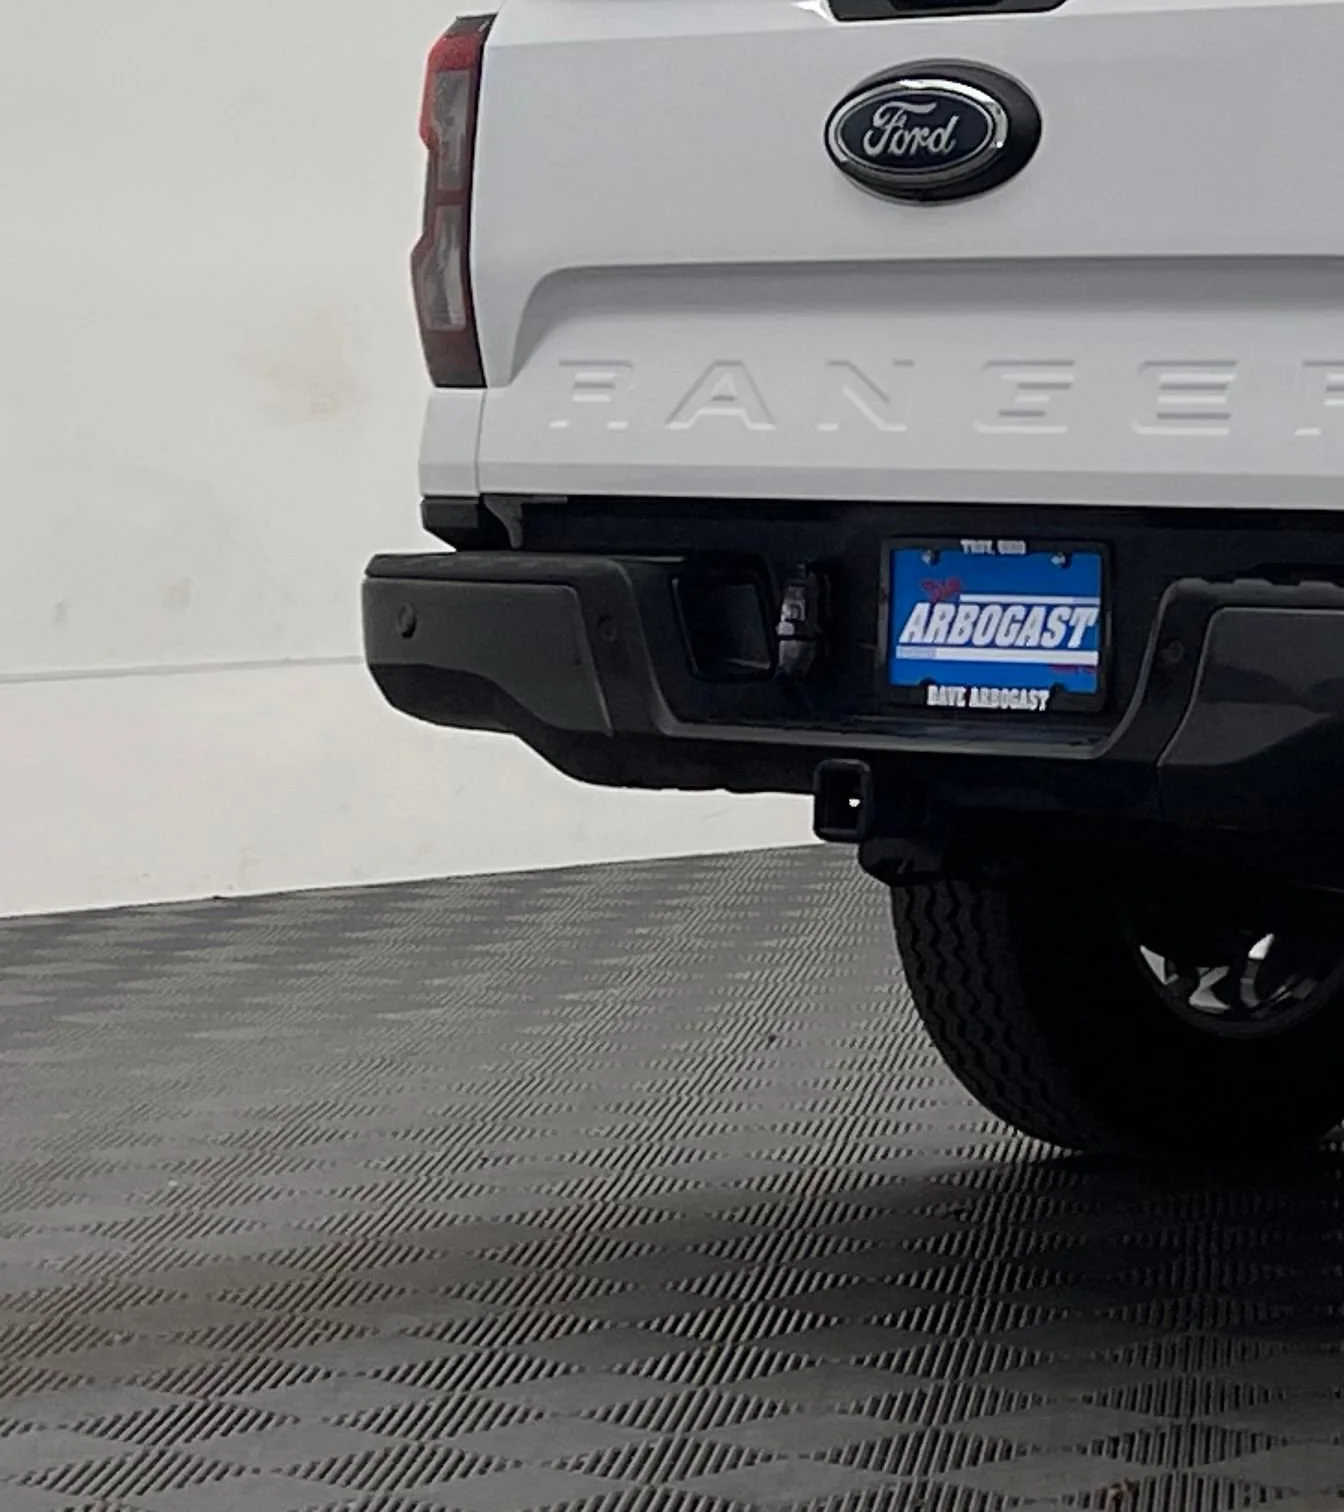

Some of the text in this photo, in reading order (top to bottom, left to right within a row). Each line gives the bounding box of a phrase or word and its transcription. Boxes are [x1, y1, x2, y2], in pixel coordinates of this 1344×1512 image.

[862, 100, 959, 158] Ford
[898, 602, 1099, 649] ARBOGAST
[927, 684, 1050, 712] DAVE ARBOGAST
